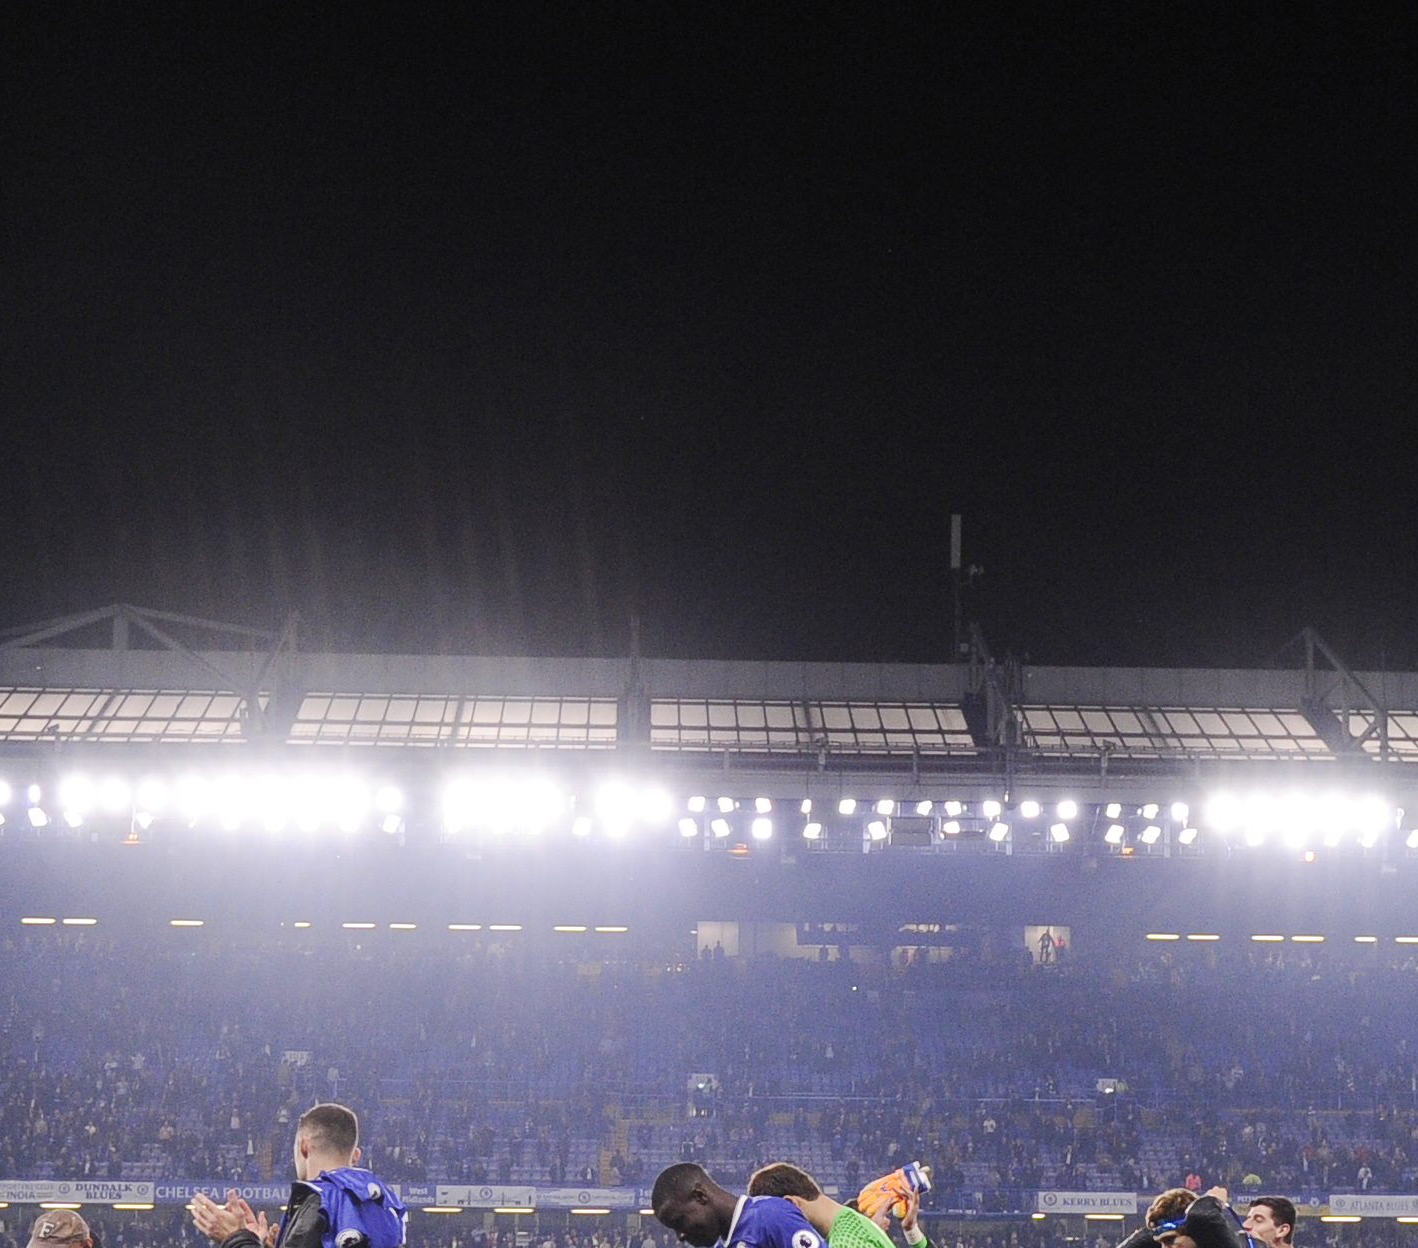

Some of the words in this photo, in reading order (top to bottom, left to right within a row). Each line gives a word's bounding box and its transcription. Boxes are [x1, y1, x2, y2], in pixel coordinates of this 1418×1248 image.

[75, 1183, 132, 1192] DUNDALK
[6, 1191, 35, 1199] INDIA
[1062, 1198, 1096, 1206] KERRY
[1100, 1198, 1132, 1206] BLUES
[1350, 1201, 1383, 1210] ATLANTA
[1386, 1202, 1409, 1211] BLUES
[39, 1222, 55, 1238] F
